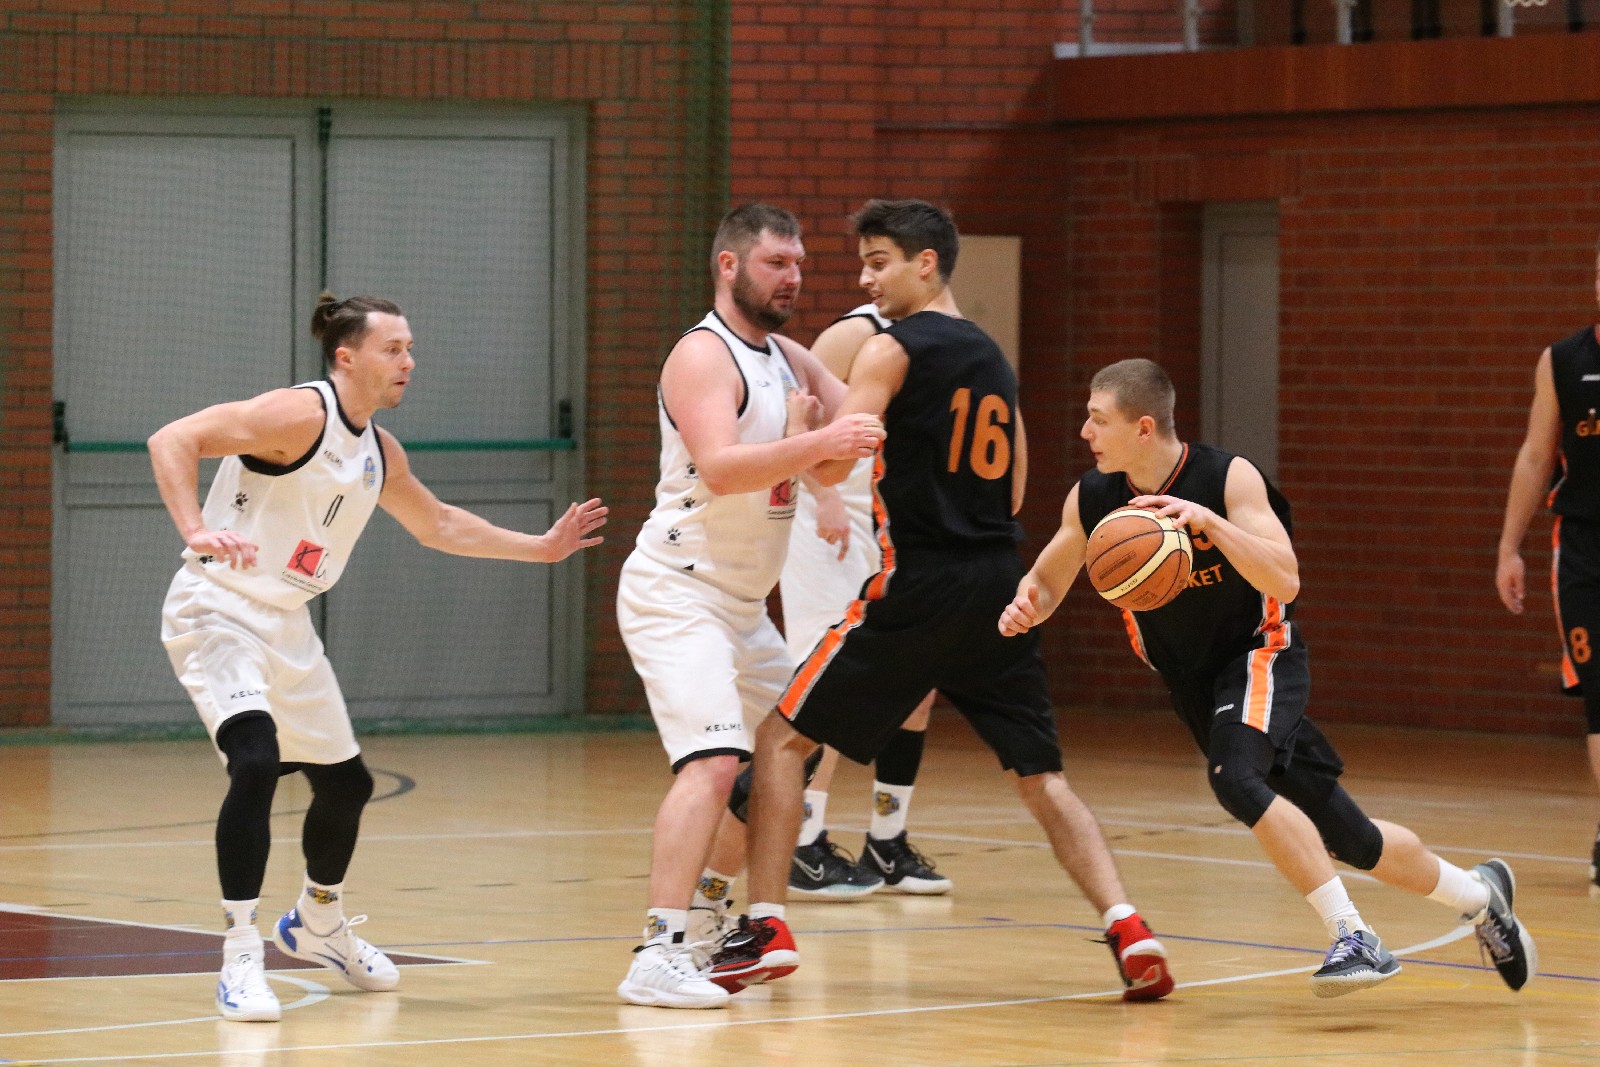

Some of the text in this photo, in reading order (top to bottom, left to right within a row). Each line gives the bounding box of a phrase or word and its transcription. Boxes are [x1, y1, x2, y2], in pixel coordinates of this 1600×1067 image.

[947, 387, 1011, 481] 16
[1187, 563, 1223, 588] KET
[1569, 626, 1592, 663] 8
